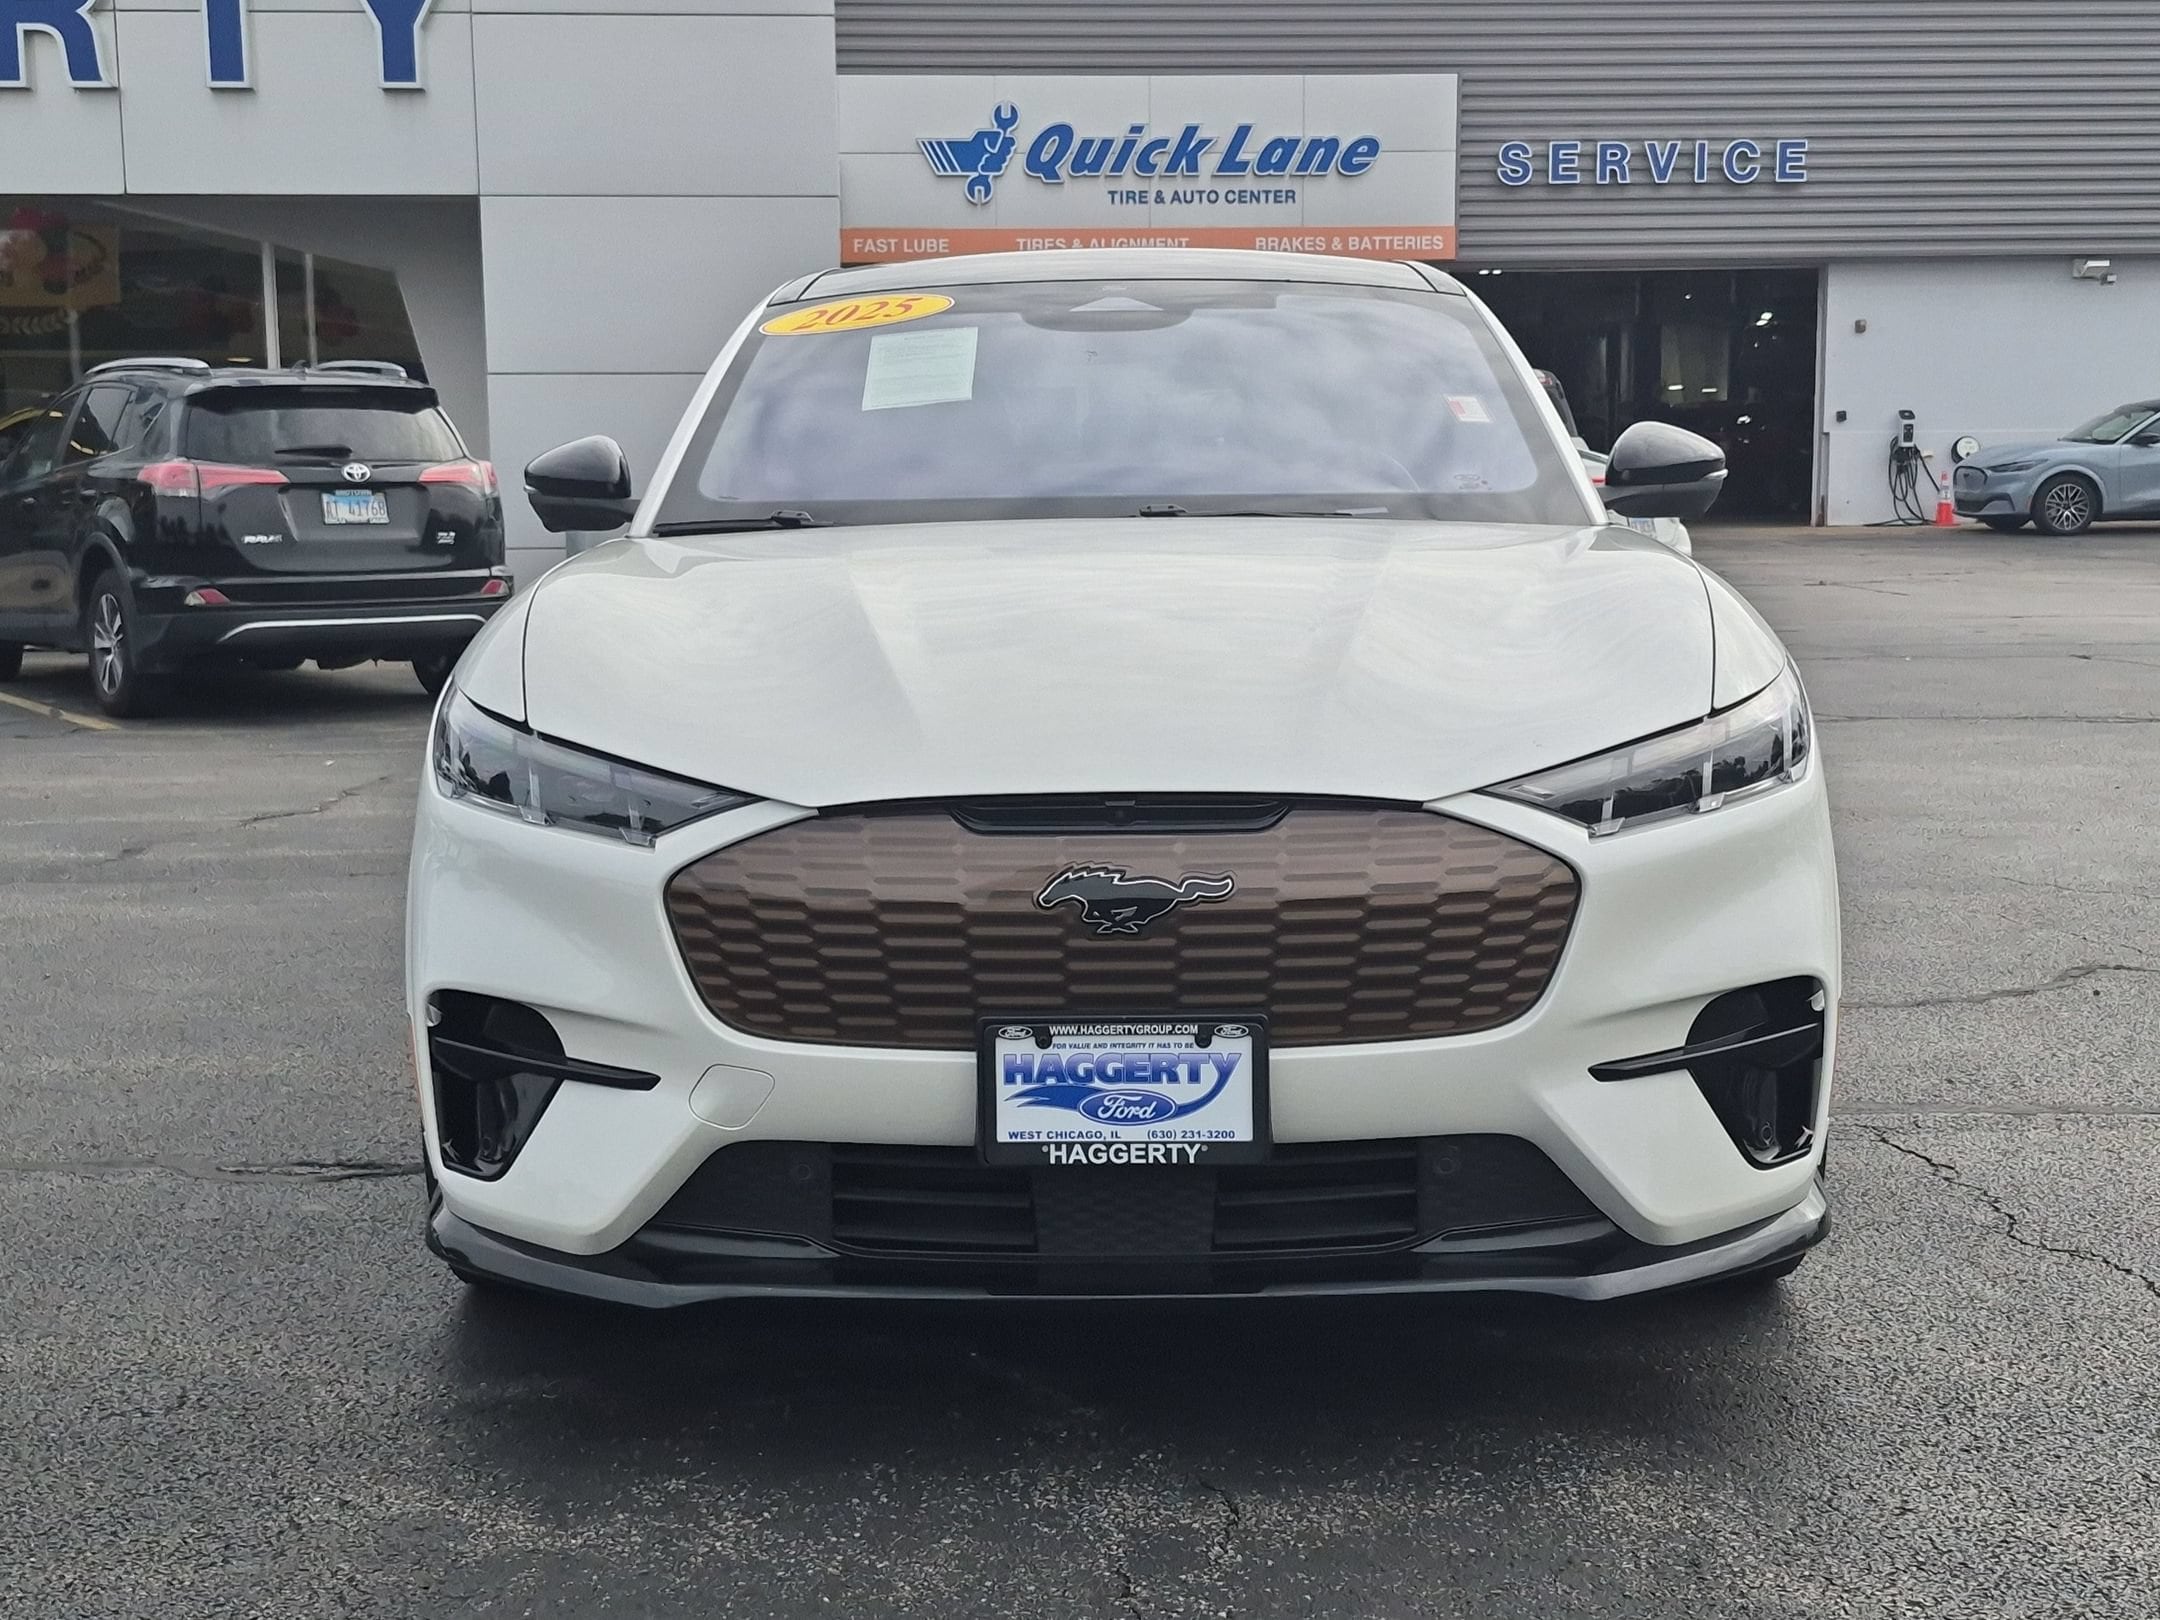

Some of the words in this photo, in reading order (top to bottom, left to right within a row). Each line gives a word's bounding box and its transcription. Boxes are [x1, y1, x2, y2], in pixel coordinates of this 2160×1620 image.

[1024, 121, 1219, 184] Quick
[1212, 122, 1382, 178] Lane
[1497, 139, 1808, 186] SERVICE
[1108, 190, 1148, 205] TIRE
[1154, 190, 1166, 204] &
[1170, 190, 1219, 204] AUTO
[1225, 189, 1296, 204] CENTER
[853, 238, 898, 253] FAST
[903, 238, 949, 253] LUBE
[1016, 238, 1066, 250] TIRES
[1255, 236, 1325, 251] BRAKES
[1331, 236, 1343, 249] &
[1348, 235, 1443, 250] BATTERIES
[790, 297, 923, 331] 2025
[1049, 1024, 1199, 1035] WWW.HAGGERTYGROUP.COM
[1003, 1052, 1242, 1087] HAGGERTY
[1097, 1094, 1156, 1120] Ford
[1008, 1131, 1042, 1140] WEST
[1046, 1130, 1107, 1141] CHICAGO,
[1110, 1130, 1121, 1139] IL
[1147, 1130, 1177, 1140] (630)
[1180, 1130, 1236, 1140] 231-3200
[1050, 1143, 1201, 1164] HAGGERTY
